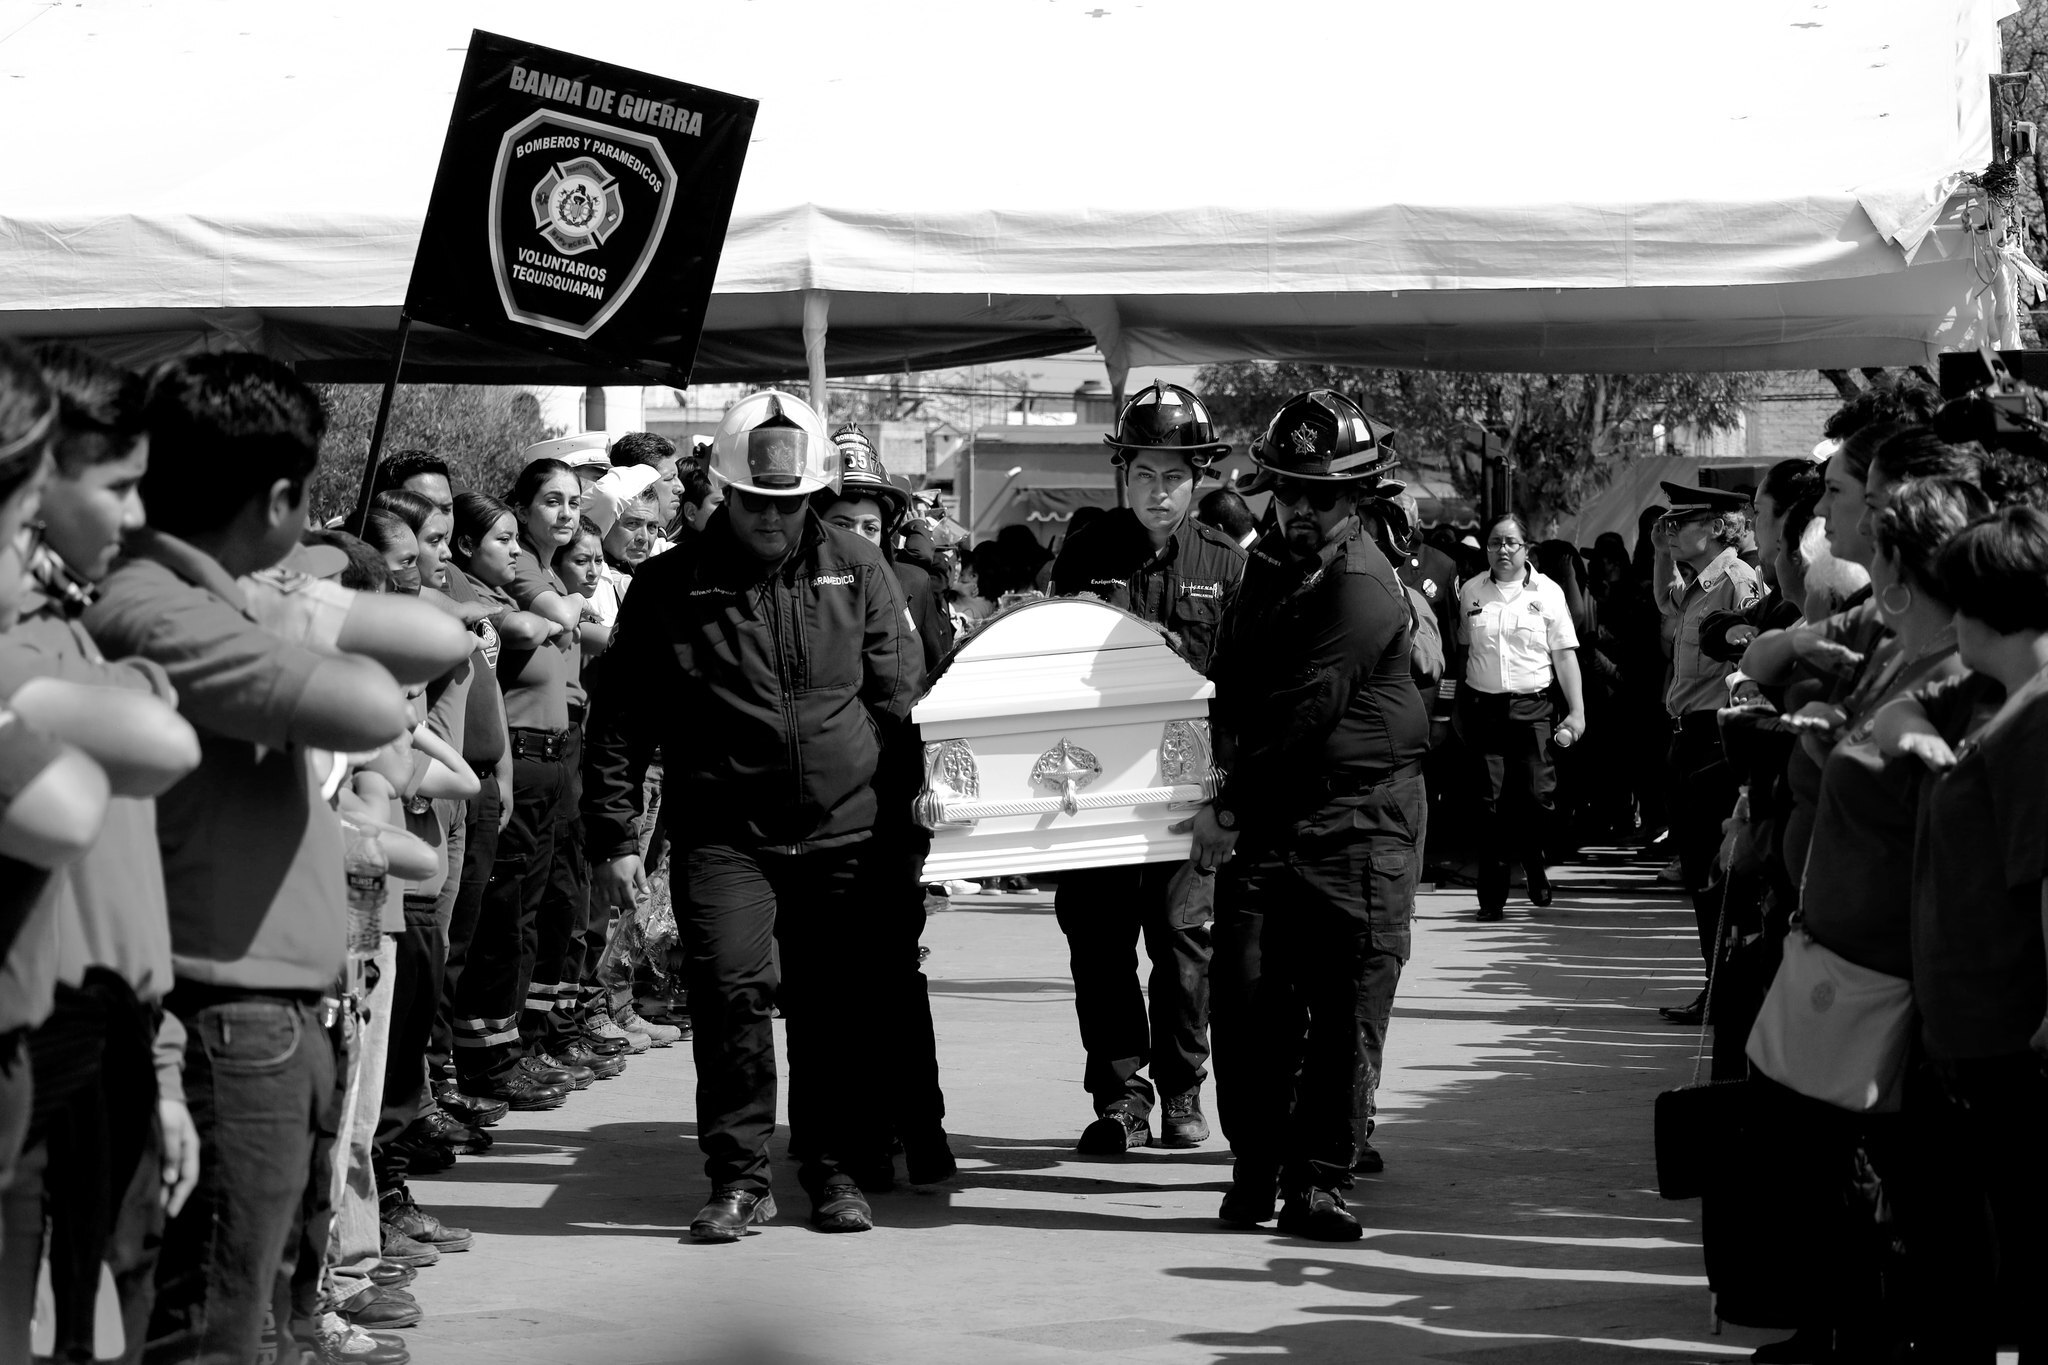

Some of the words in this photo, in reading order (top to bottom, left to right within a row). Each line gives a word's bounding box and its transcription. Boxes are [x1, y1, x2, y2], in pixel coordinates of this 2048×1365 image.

[509, 65, 584, 107] BANDA
[586, 85, 617, 115] DE
[617, 94, 703, 137] GUERRA
[516, 136, 581, 159] BOMBEROS
[583, 137, 592, 151] Y
[592, 142, 663, 194] PARAMEDICOS
[512, 264, 604, 300] TEQUISQUIAPAN
[518, 247, 607, 282] VOLUNTARIOS
